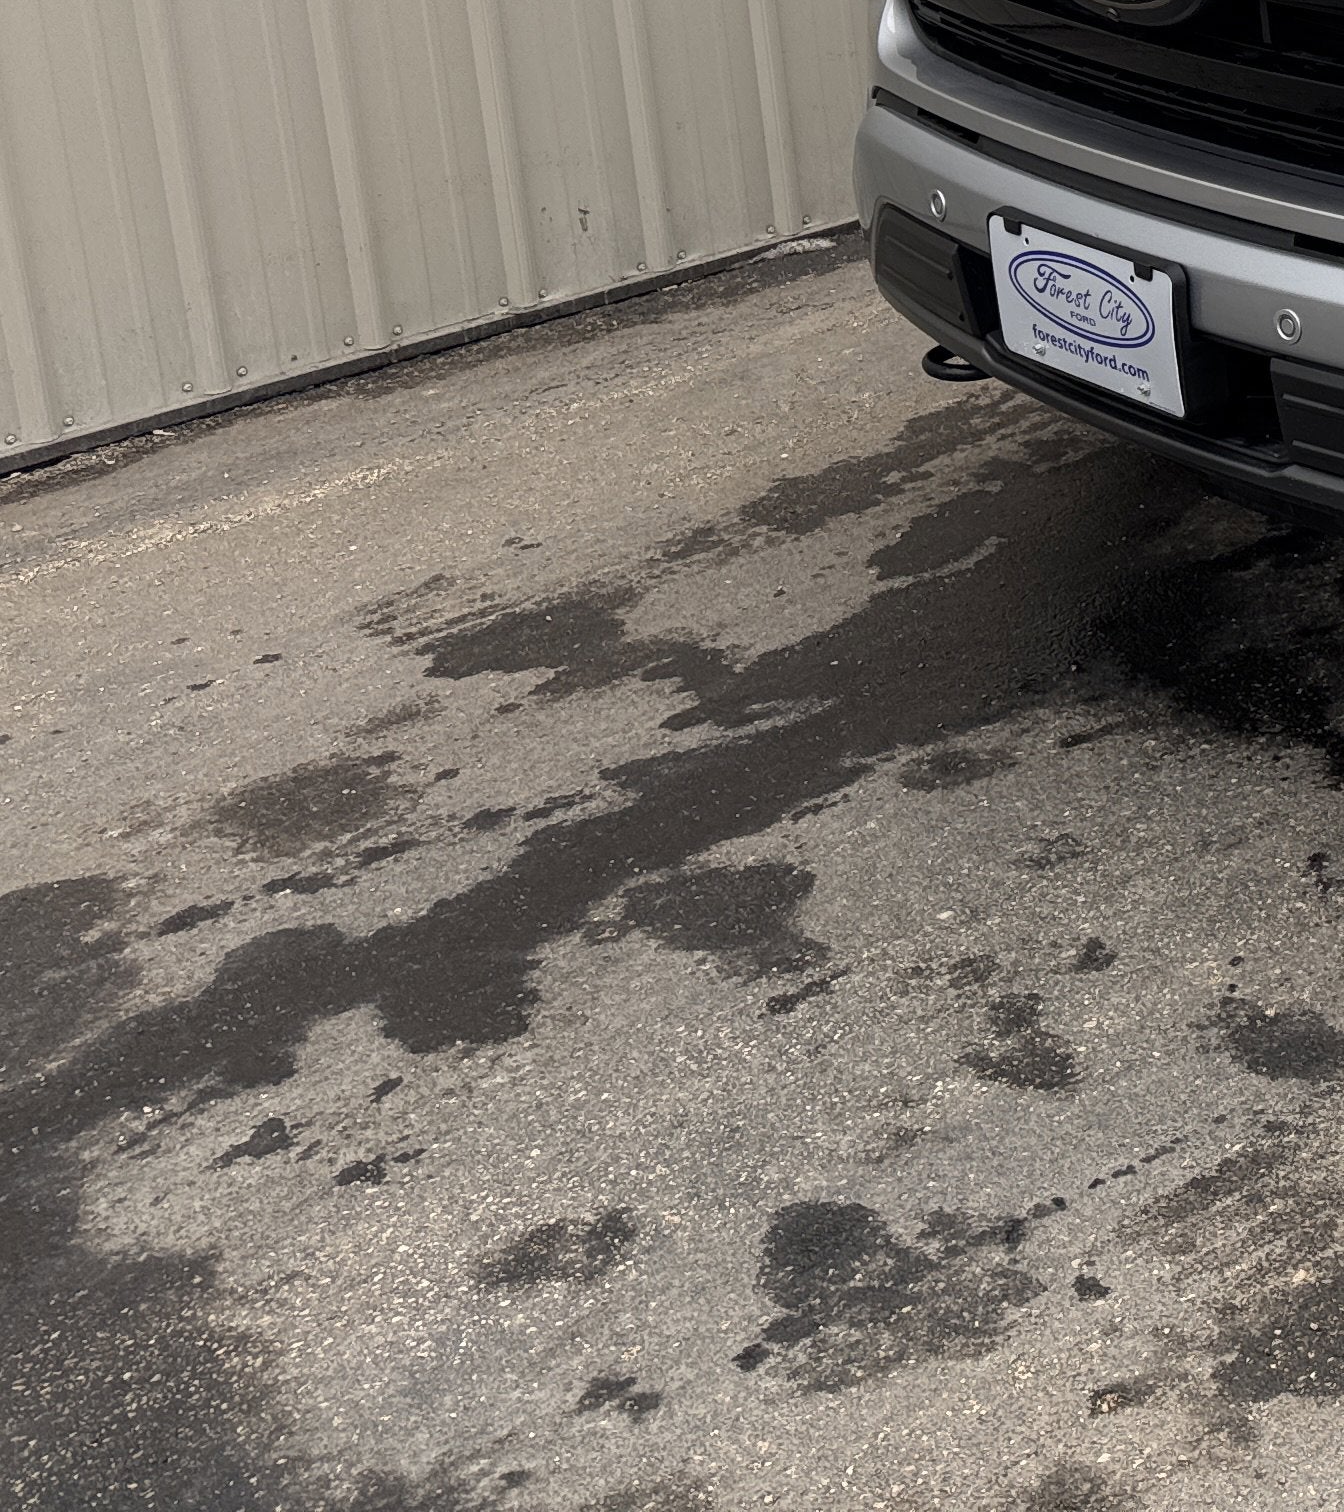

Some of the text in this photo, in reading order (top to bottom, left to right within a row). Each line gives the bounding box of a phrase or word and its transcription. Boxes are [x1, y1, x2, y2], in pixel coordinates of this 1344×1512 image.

[1033, 263, 1134, 336] Forest City
[1069, 310, 1096, 327] FORD
[1032, 324, 1150, 382] forestcityford.com
